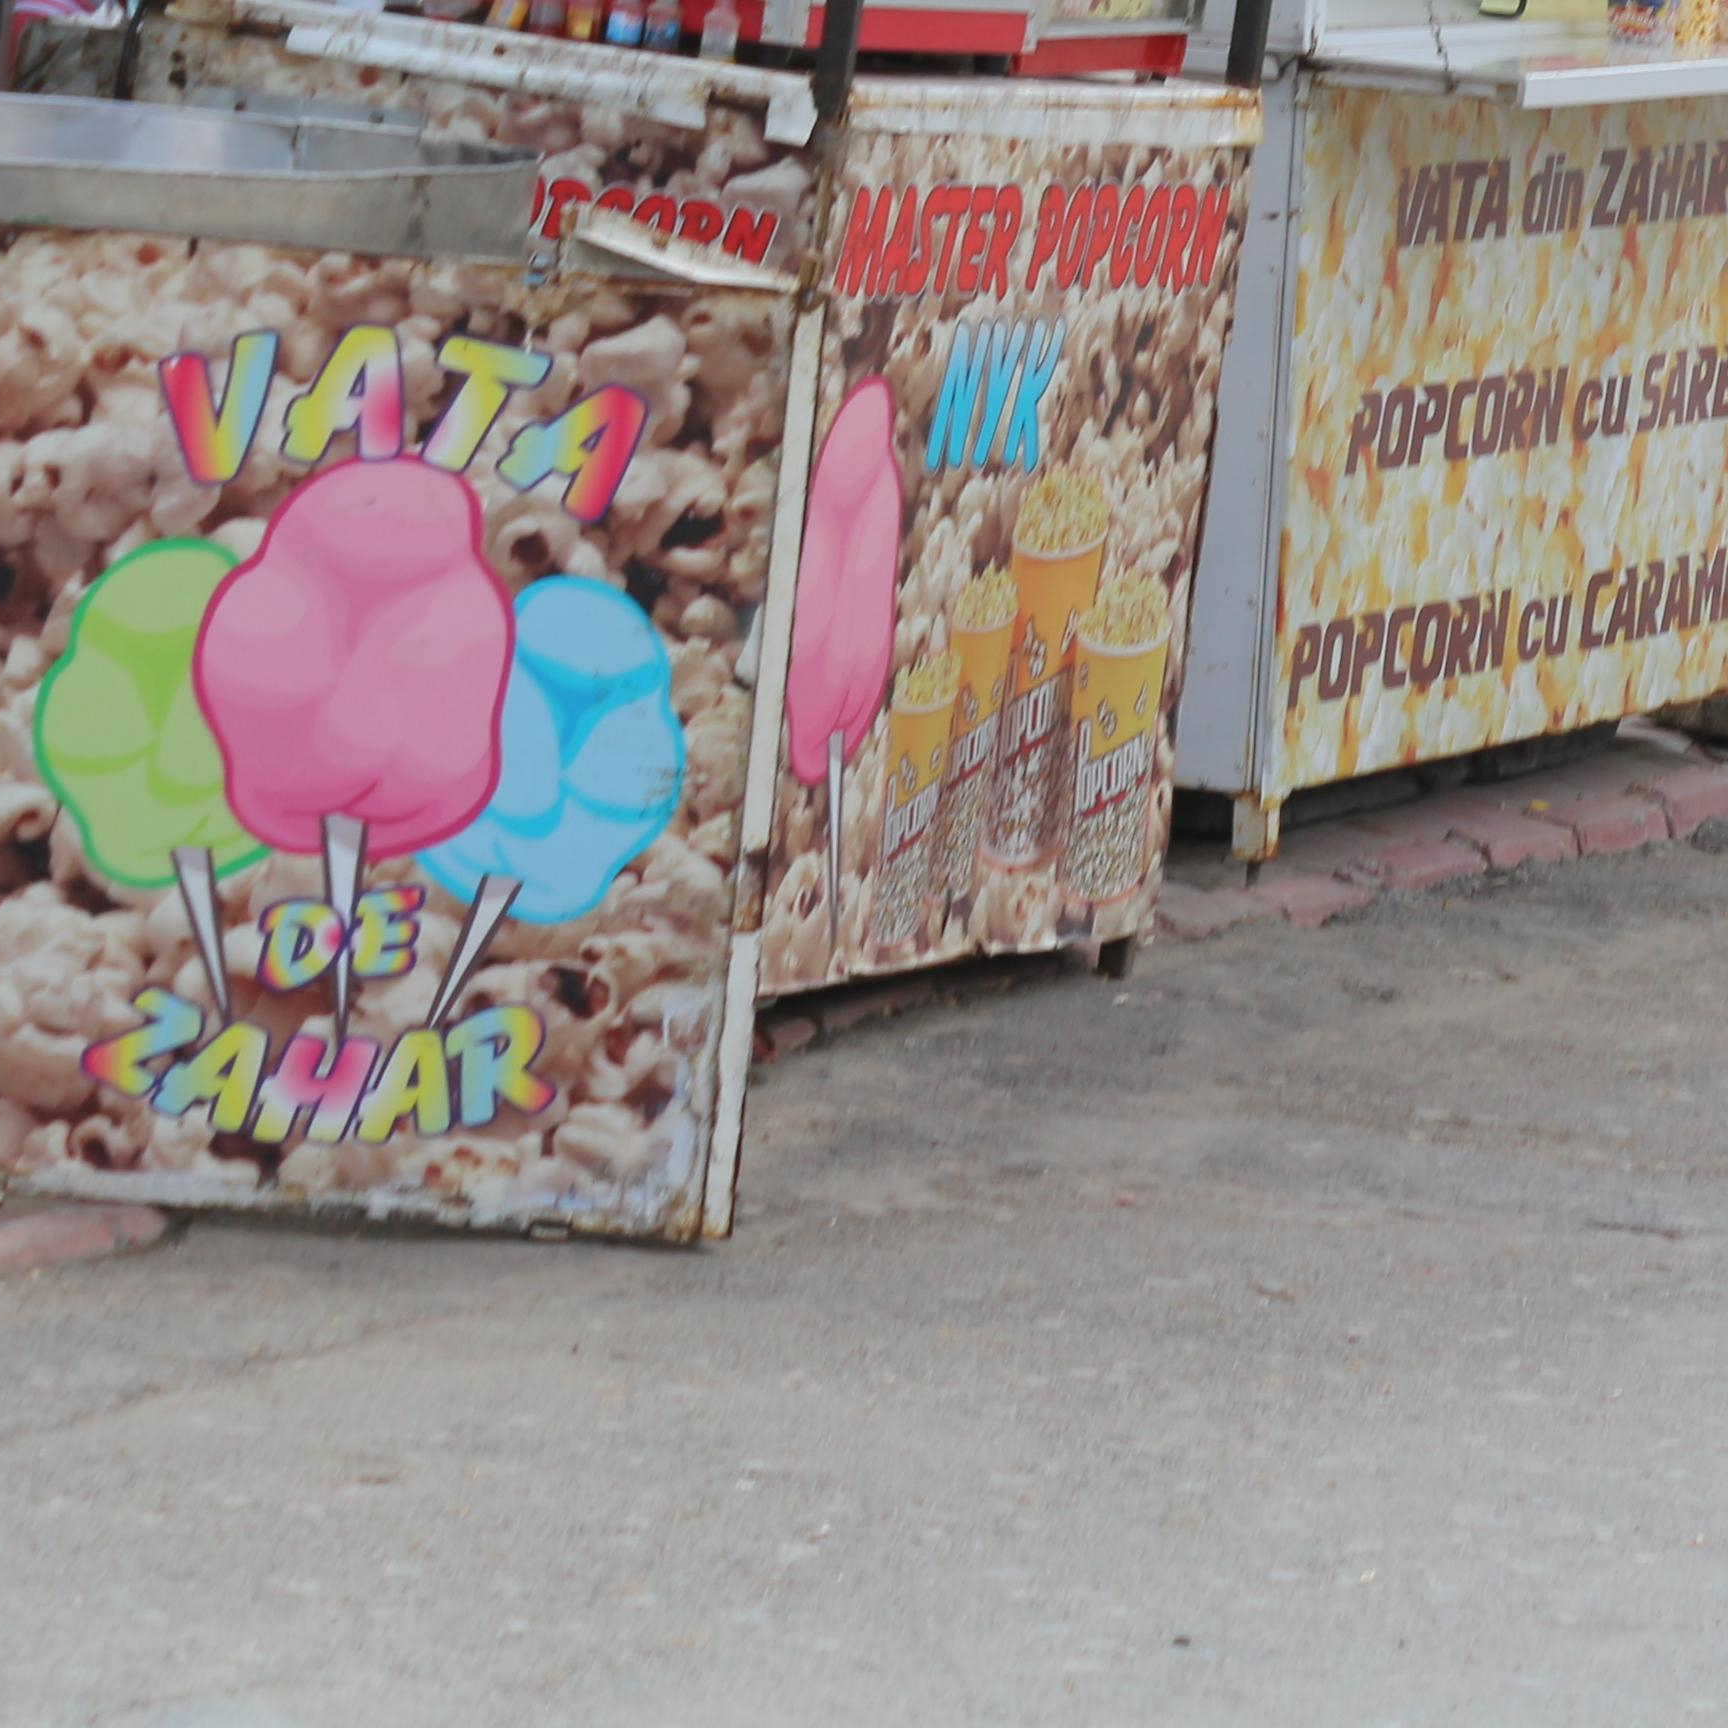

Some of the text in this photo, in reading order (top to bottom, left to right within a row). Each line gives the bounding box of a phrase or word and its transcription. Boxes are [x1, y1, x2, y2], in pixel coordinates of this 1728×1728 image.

[833, 183, 1231, 299] MASTER POPCORN
[1396, 158, 1511, 249] VATA
[1522, 154, 1585, 234] din
[158, 324, 648, 522] VATA
[924, 316, 1066, 472] NYK
[1345, 365, 1569, 475] POPCORN
[1572, 375, 1633, 440] cu
[1287, 588, 1512, 710] POPCORN
[1517, 593, 1573, 661] cu
[1074, 719, 1146, 817] POPCORN
[257, 885, 424, 992] DE
[80, 986, 556, 1146] ZAHAR
